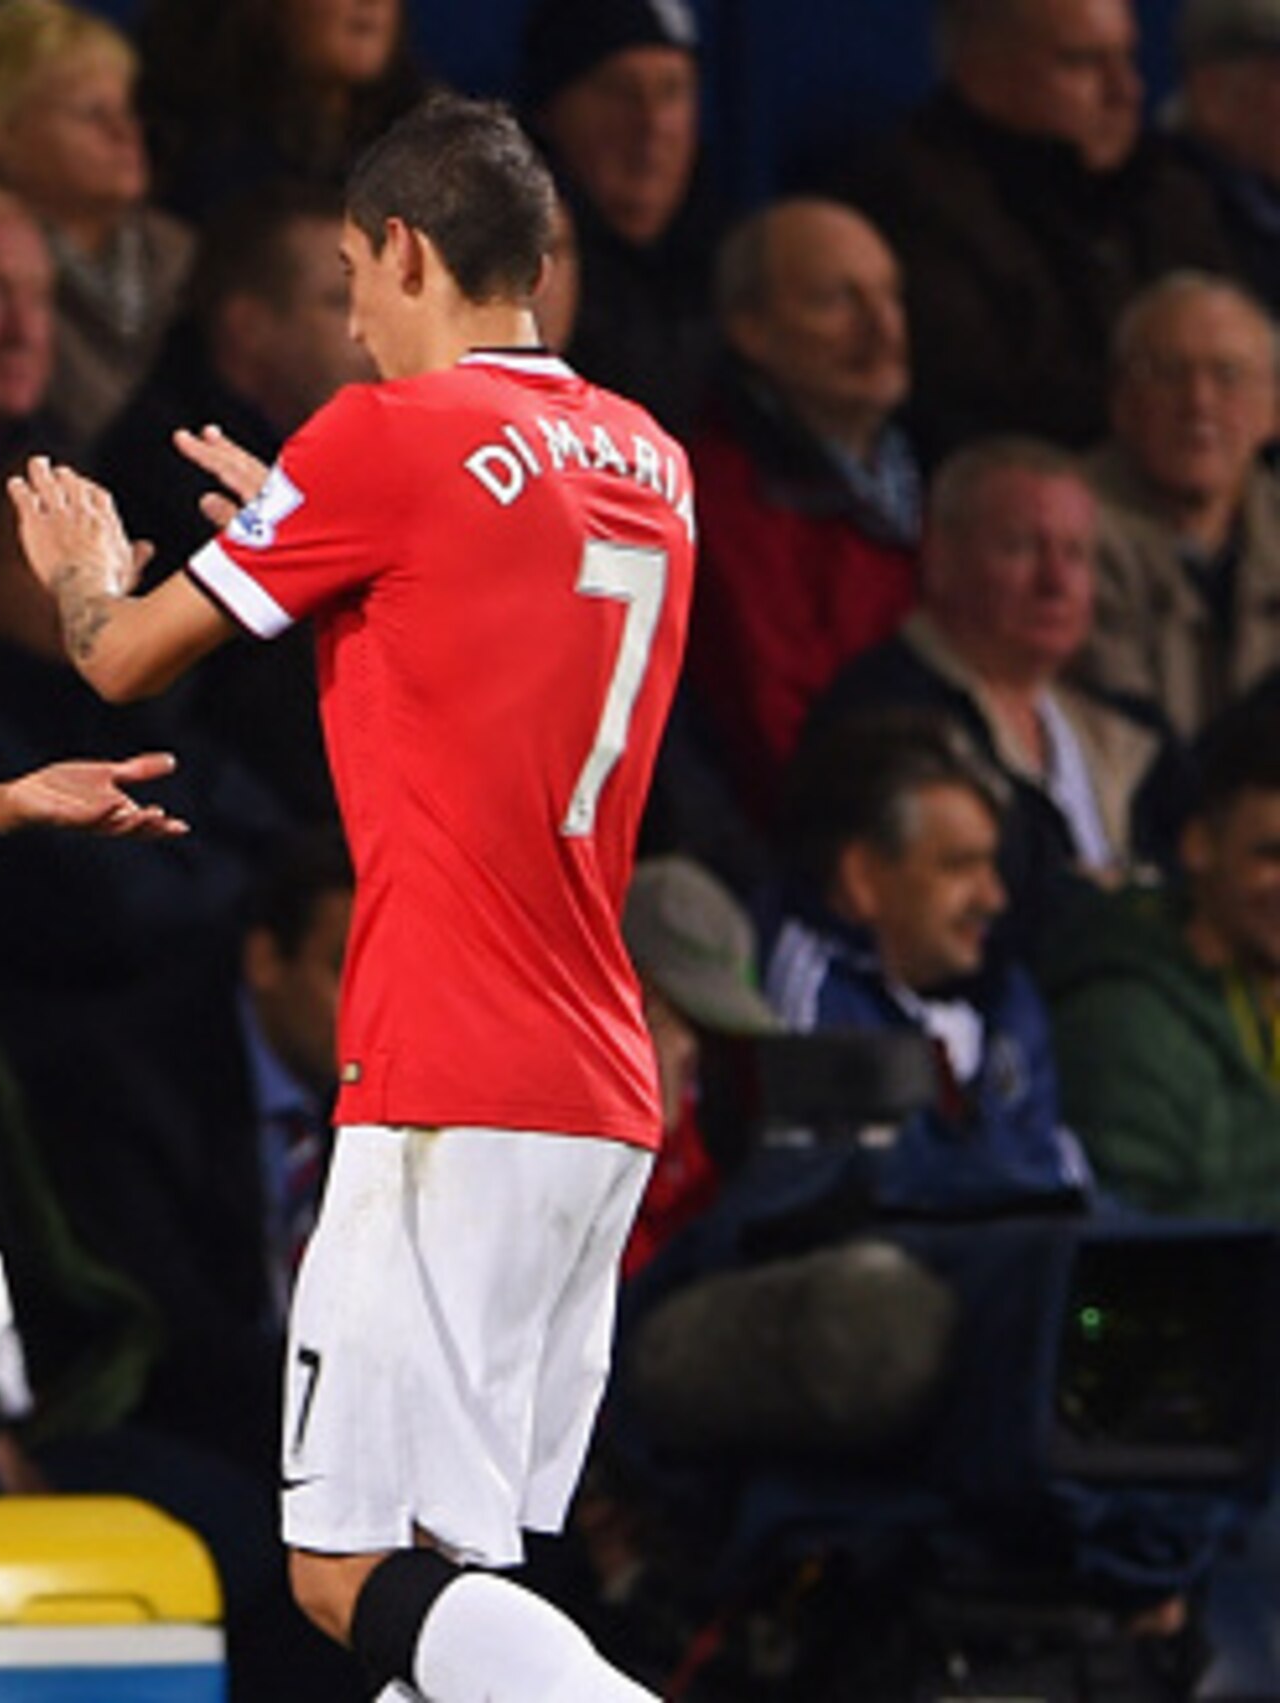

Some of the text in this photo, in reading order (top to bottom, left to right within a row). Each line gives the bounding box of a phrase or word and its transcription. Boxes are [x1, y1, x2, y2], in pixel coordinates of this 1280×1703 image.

[464, 424, 542, 505] DI
[561, 540, 668, 837] 7
[291, 1346, 321, 1457] 7
